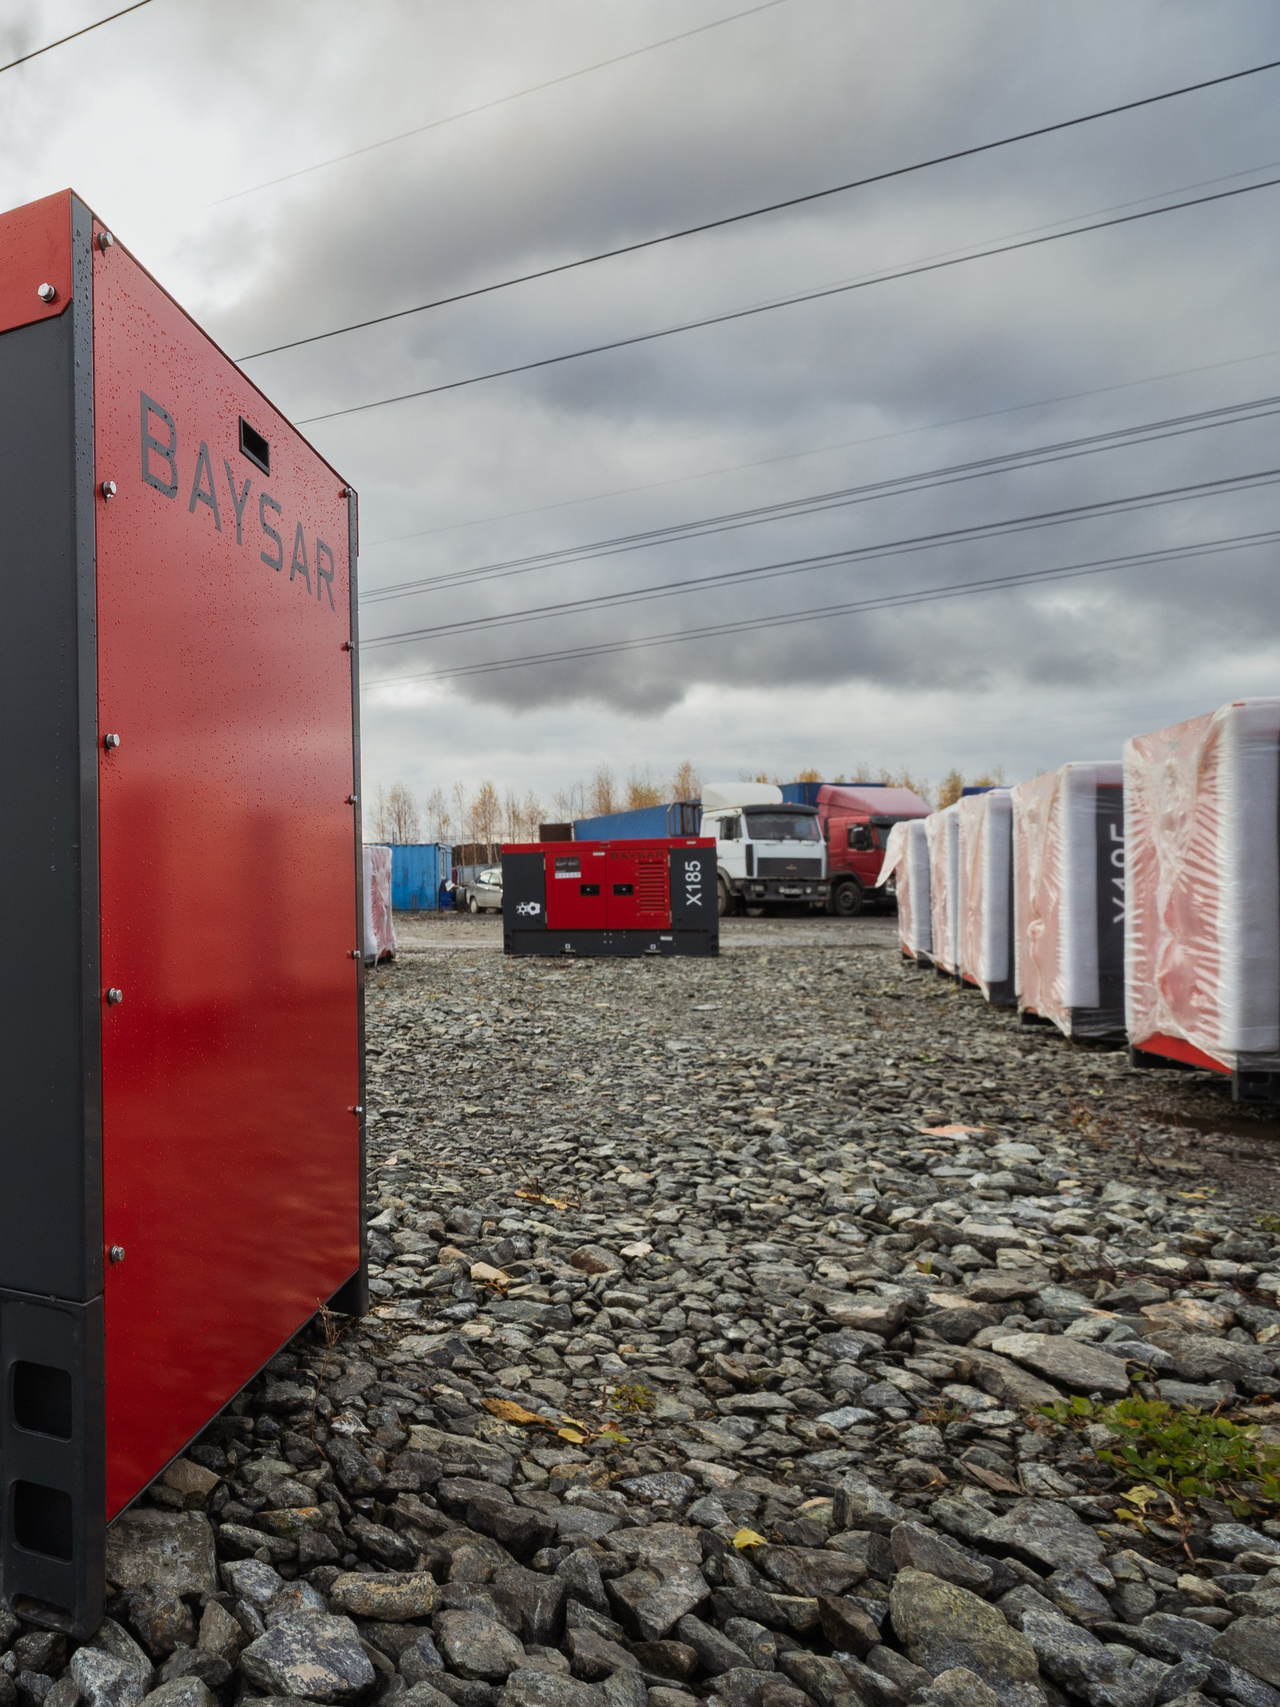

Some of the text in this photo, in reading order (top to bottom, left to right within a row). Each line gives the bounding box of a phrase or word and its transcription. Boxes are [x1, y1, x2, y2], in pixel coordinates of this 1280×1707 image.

[140, 390, 336, 612] BAYSAR
[610, 851, 664, 860] BAYSAR
[685, 861, 702, 906] X185
